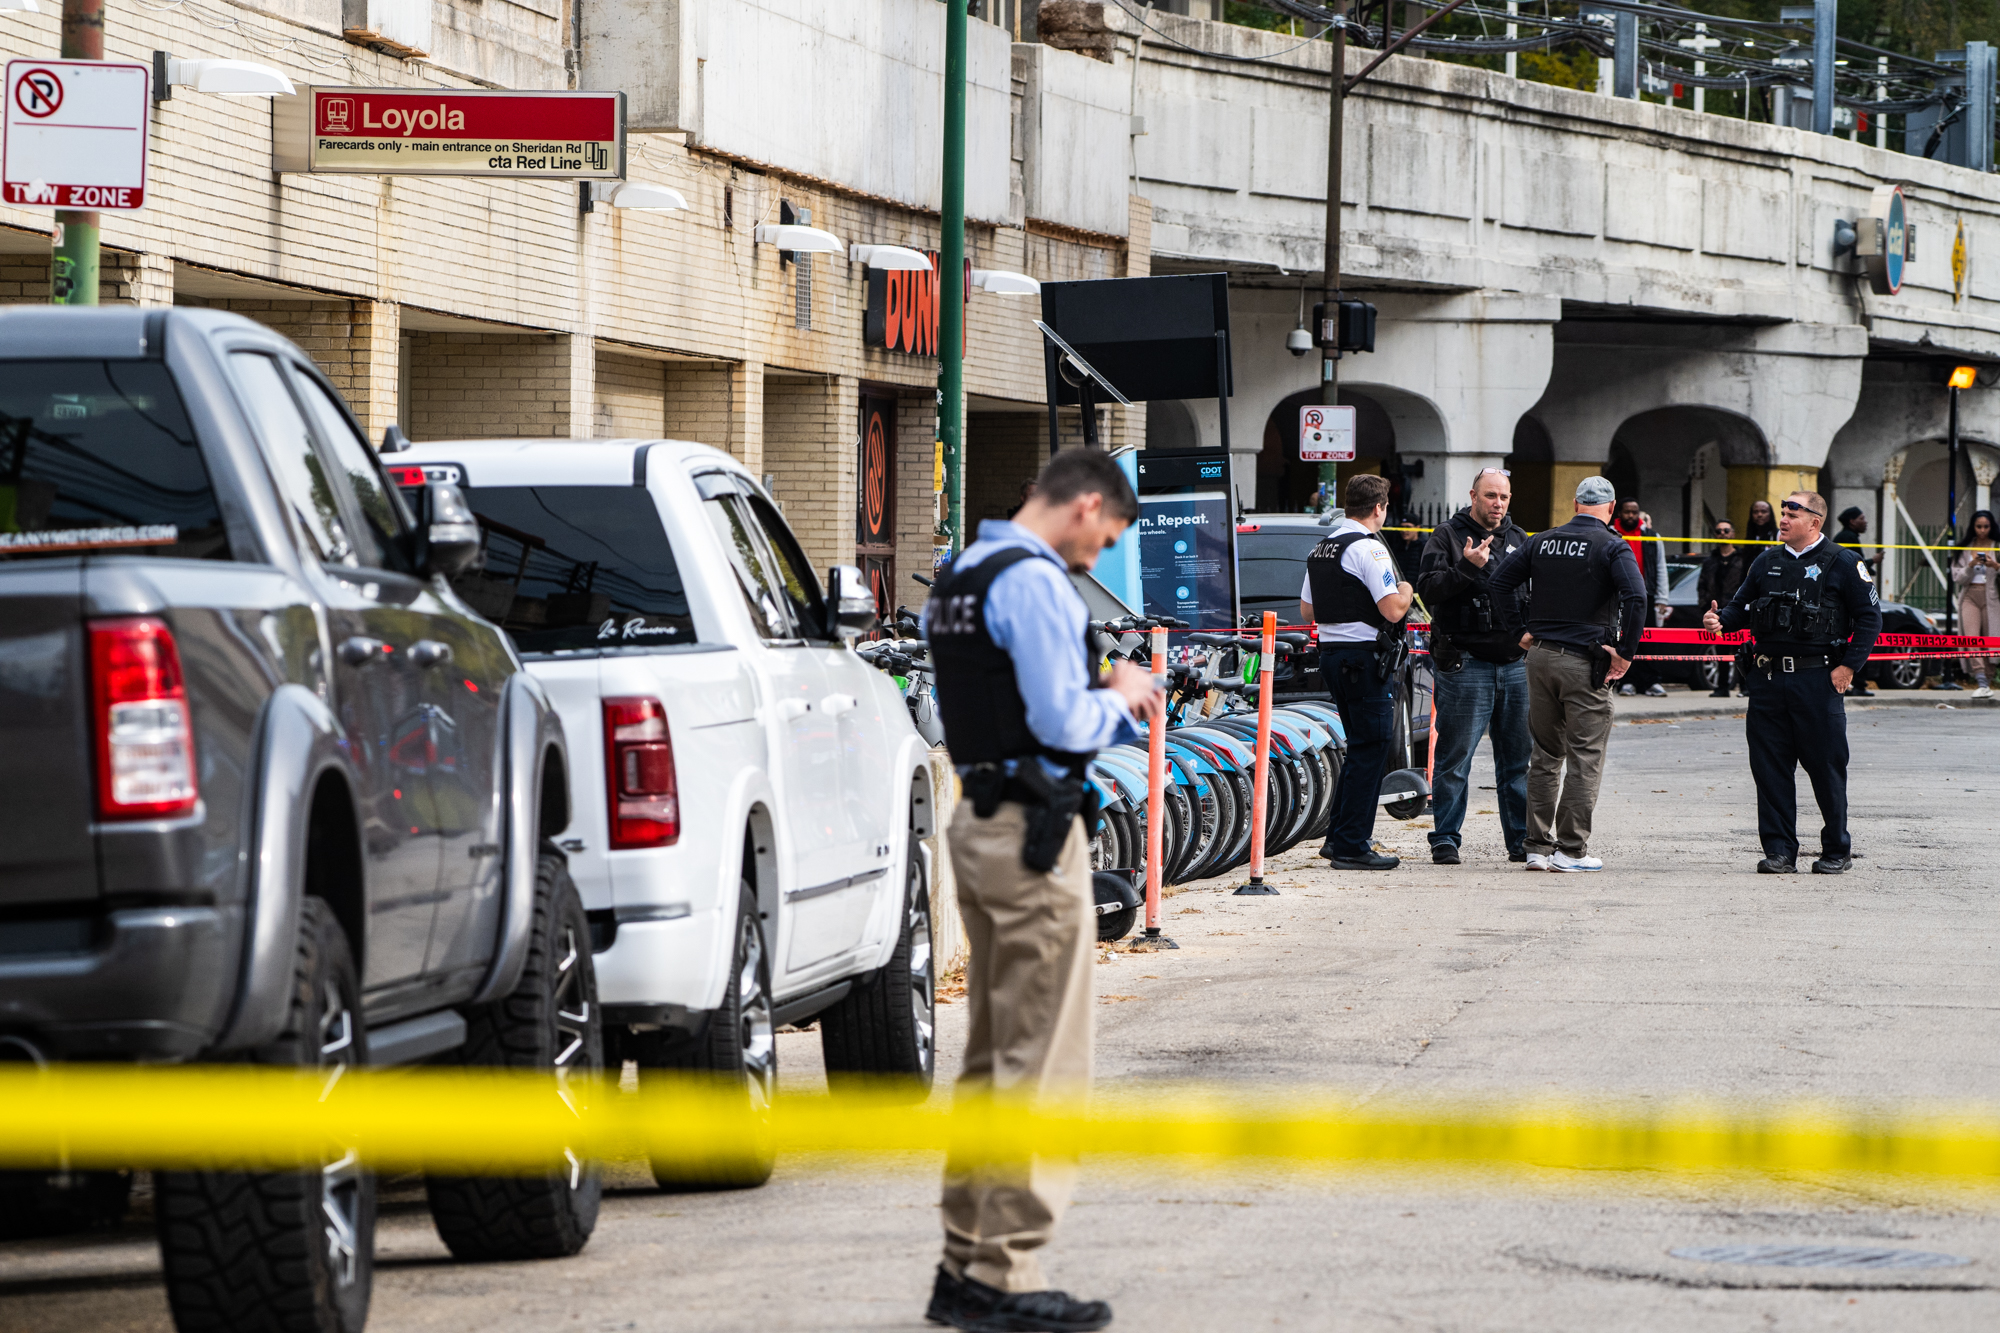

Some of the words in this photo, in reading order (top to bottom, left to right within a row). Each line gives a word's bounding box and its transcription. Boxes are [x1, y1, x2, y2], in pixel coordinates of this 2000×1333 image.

[363, 102, 465, 136] Loyola
[319, 139, 375, 151] Farecards
[377, 140, 402, 153] only
[411, 141, 439, 151] main
[442, 142, 492, 153] entrance
[495, 143, 510, 153] on
[512, 141, 563, 154] Sheridan
[566, 143, 581, 154] Rd
[488, 155, 512, 169] cta
[516, 156, 546, 169] Red
[550, 156, 581, 170] Line
[69, 186, 132, 207] ZONE
[1200, 466, 1222, 475] CDOT
[1157, 513, 1209, 528] Repeat.
[1539, 540, 1588, 556] POLICE
